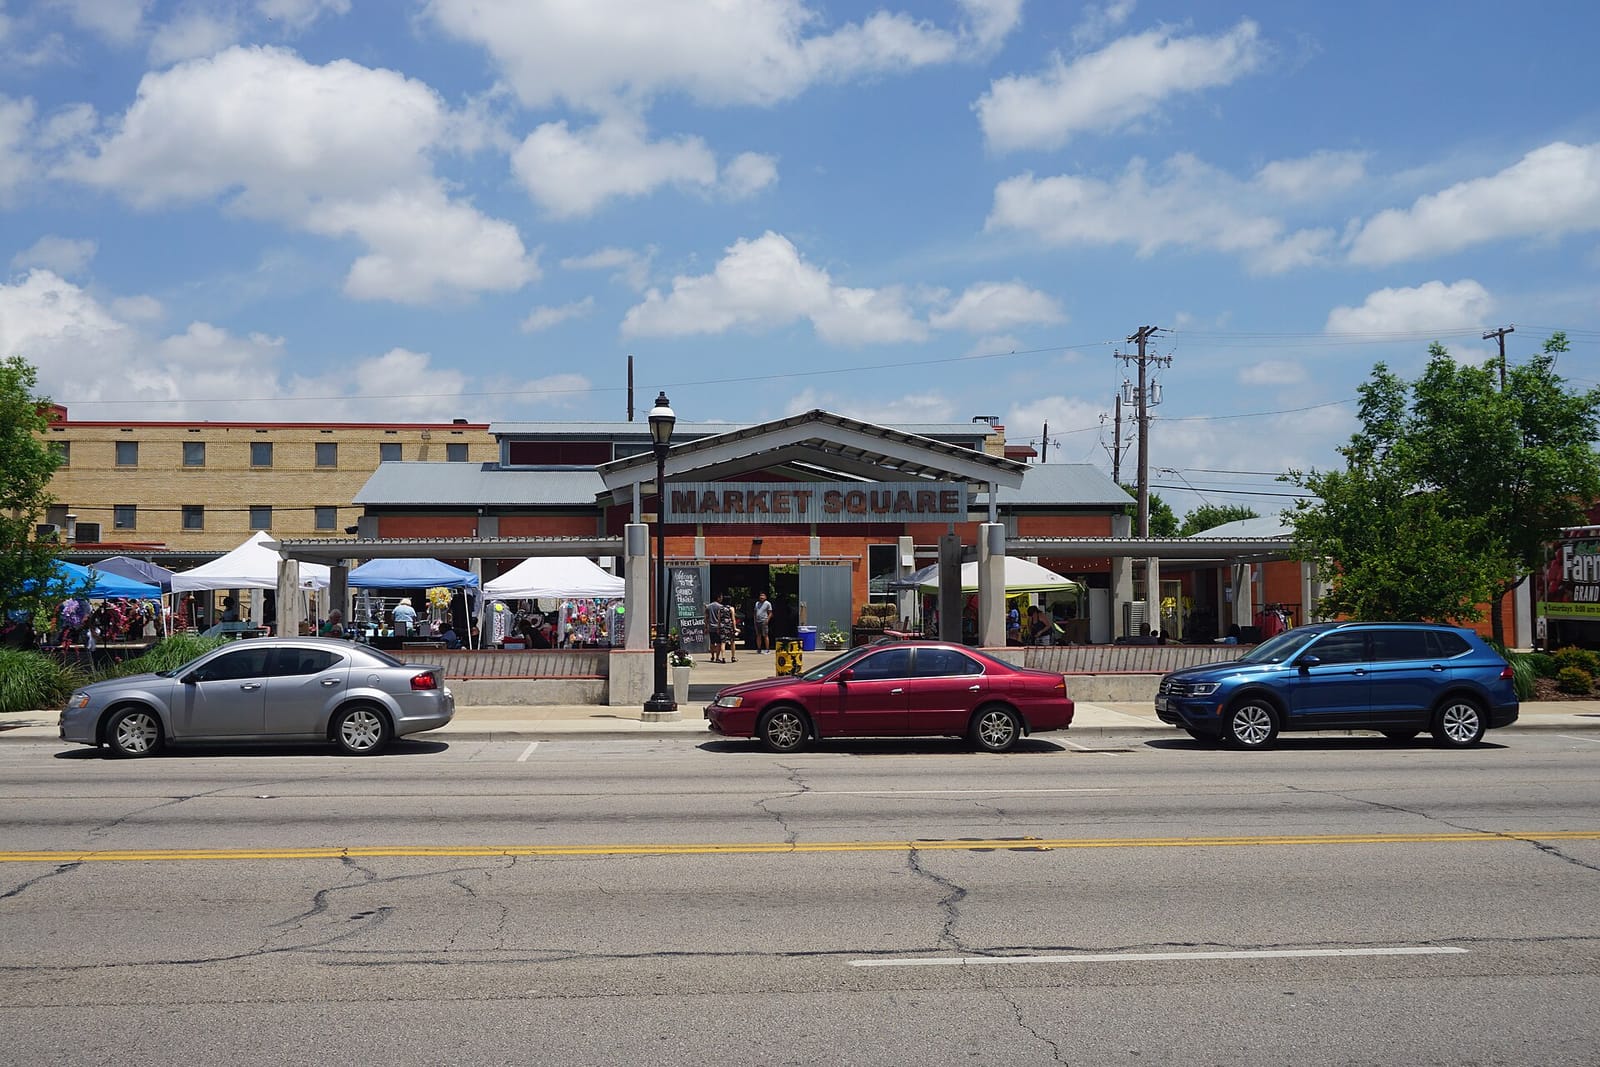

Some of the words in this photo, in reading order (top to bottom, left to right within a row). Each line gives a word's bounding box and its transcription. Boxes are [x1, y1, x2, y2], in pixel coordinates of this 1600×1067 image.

[672, 491, 812, 513] MARKET
[822, 490, 959, 515] SQUARE
[1573, 586, 1599, 602] GRAND
